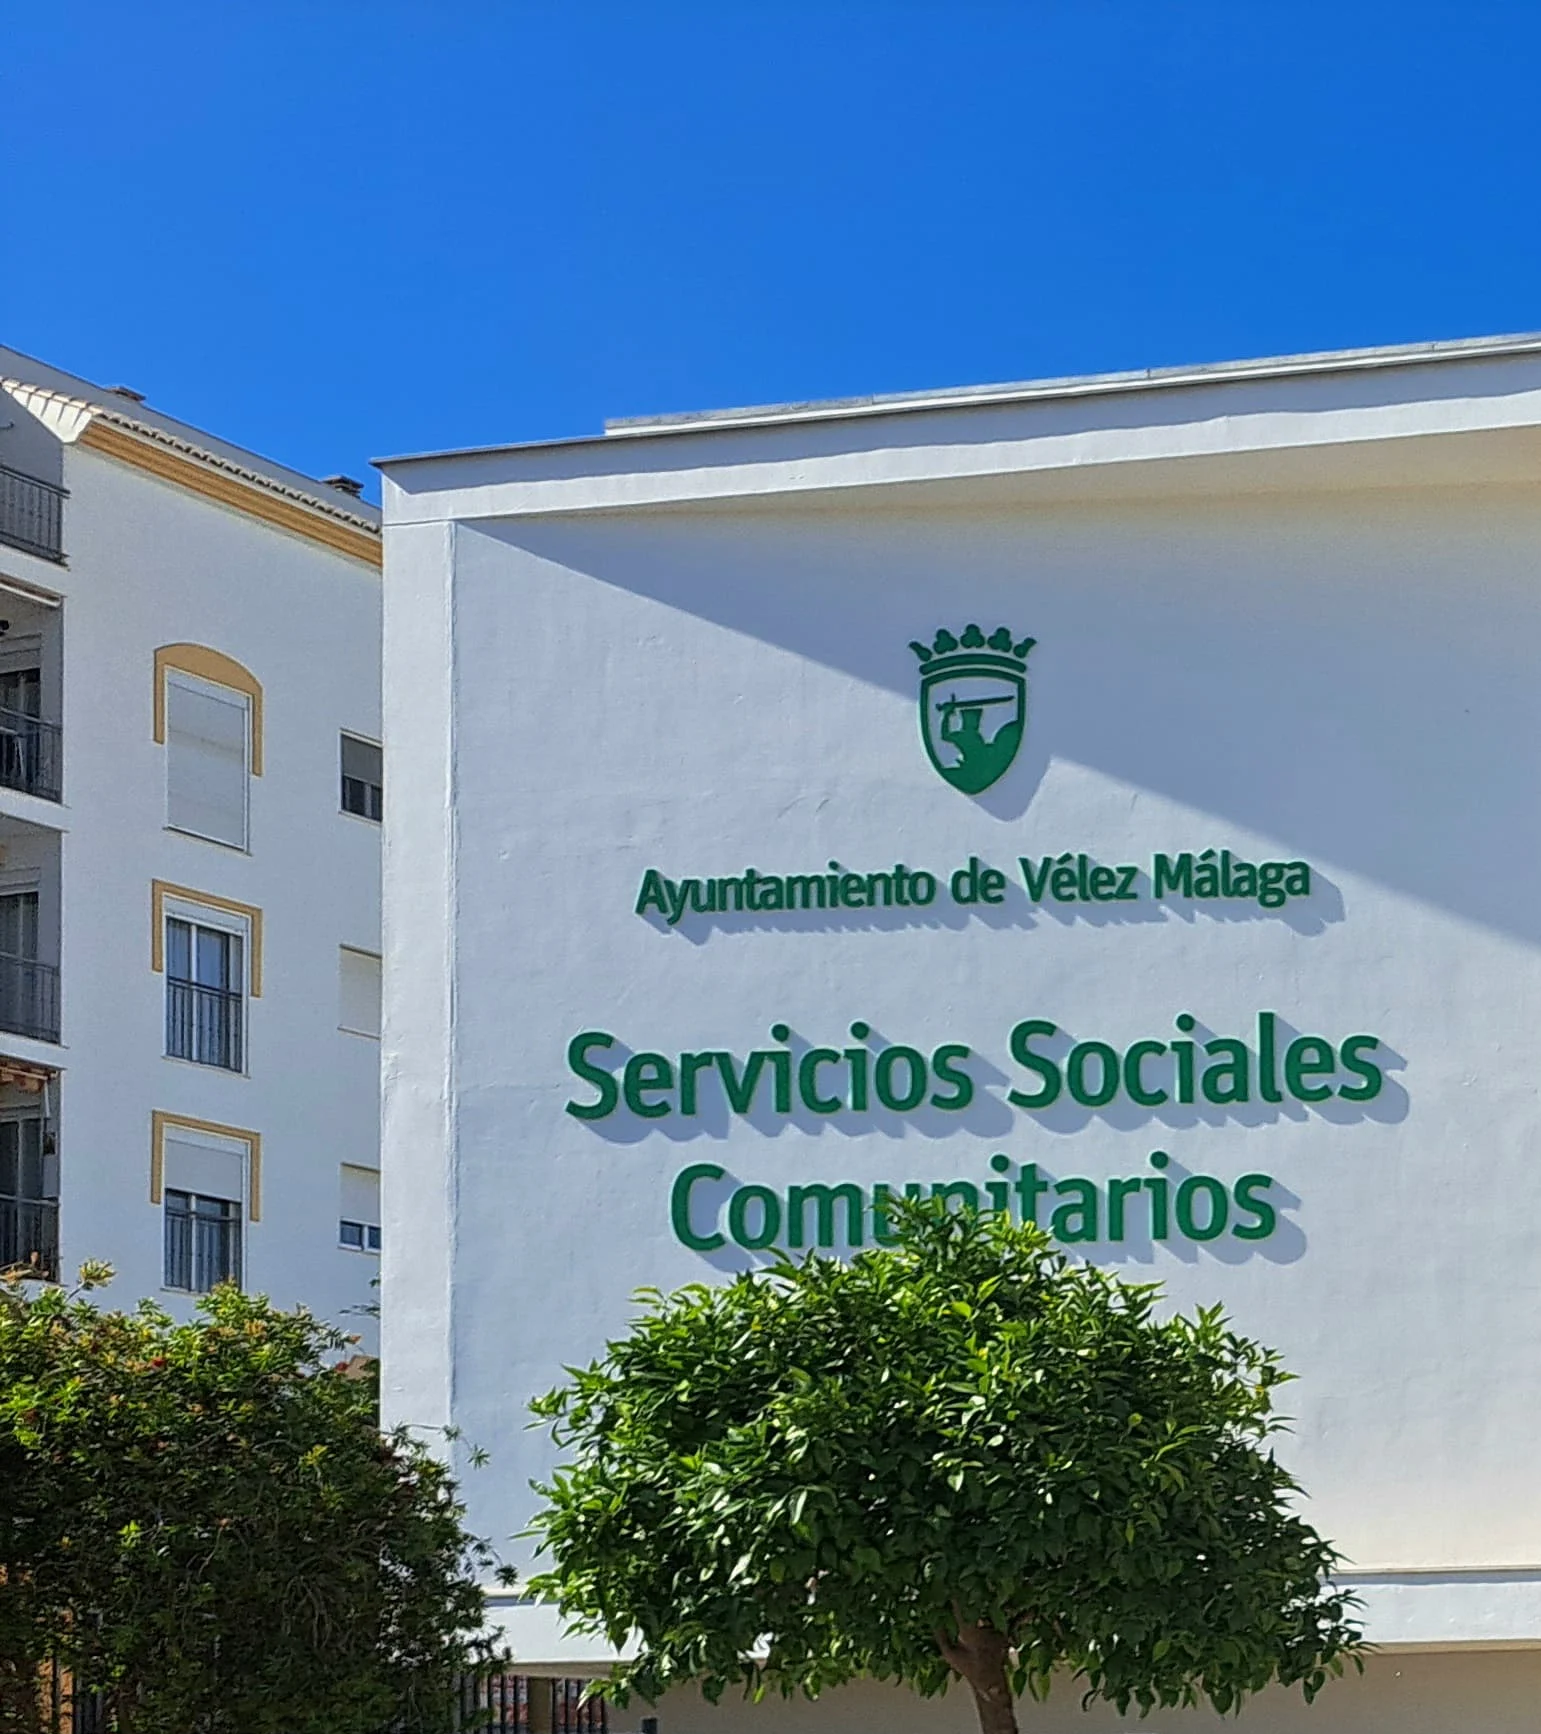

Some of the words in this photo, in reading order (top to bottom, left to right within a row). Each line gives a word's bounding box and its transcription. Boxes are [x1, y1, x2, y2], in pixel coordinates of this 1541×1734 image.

[634, 860, 938, 926] Ayuntamiento
[949, 856, 1009, 905] de
[1018, 852, 1142, 904] Vélez
[1152, 848, 1313, 910] Málaga
[564, 1021, 976, 1121] Servicios
[1007, 1011, 1385, 1110] Sociales
